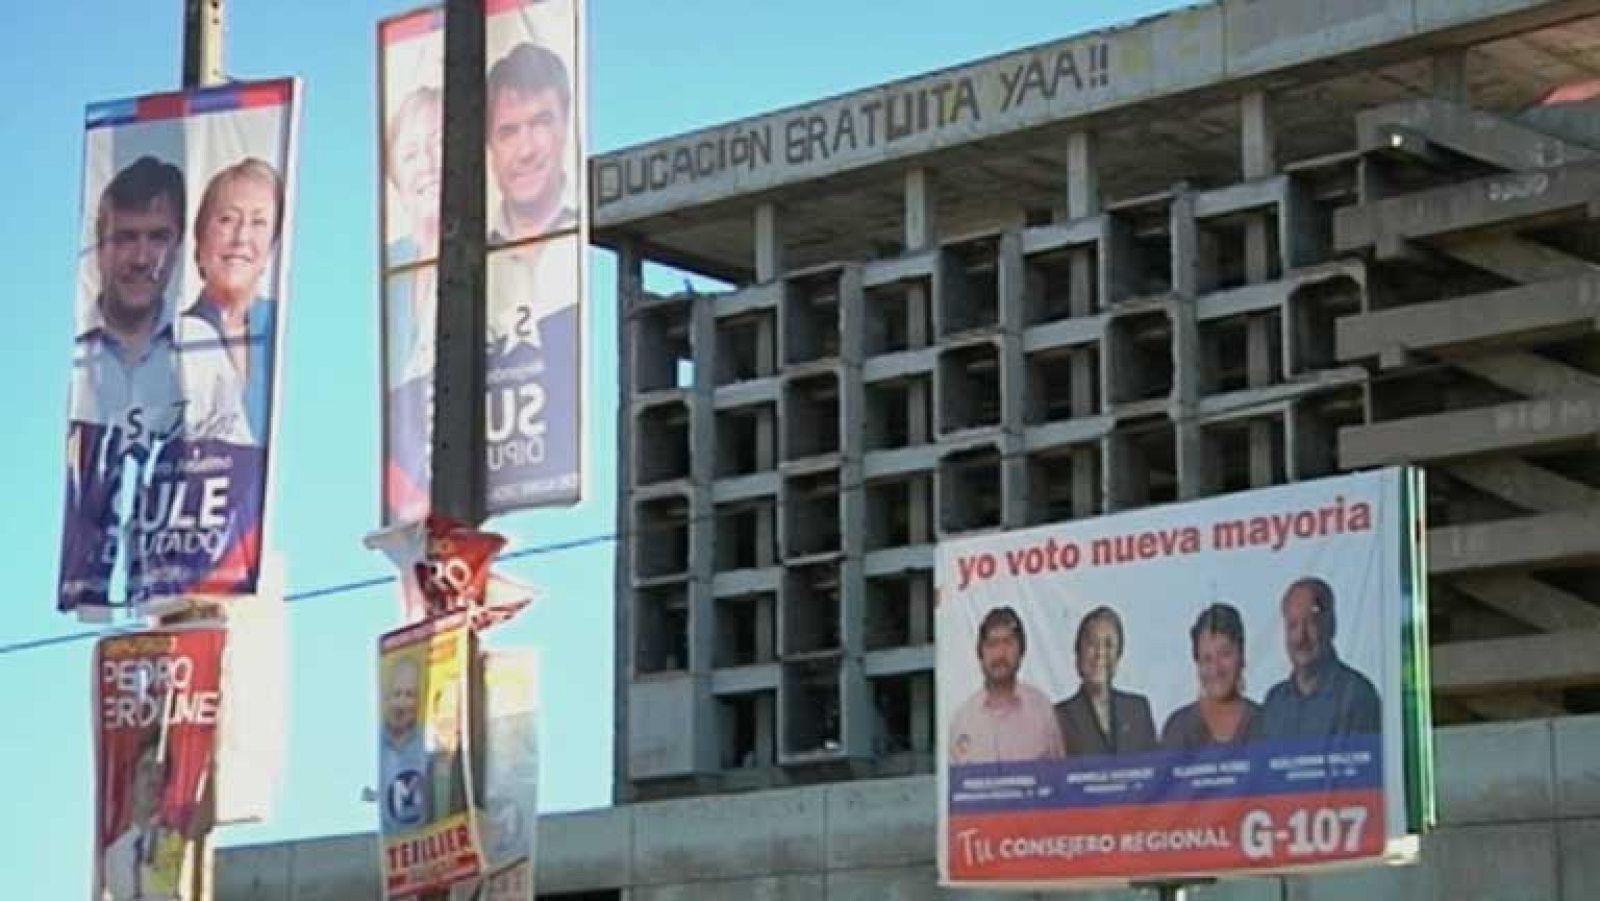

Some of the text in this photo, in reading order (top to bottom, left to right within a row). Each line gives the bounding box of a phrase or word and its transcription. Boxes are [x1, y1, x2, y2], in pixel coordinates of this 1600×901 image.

[785, 77, 981, 164] GRATUITA
[957, 495, 1371, 590] yo voto nueva mayoria
[1000, 833, 1117, 860] CONSEJERO
[1120, 826, 1232, 855] REGIONAL
[1240, 805, 1368, 859] G-107
